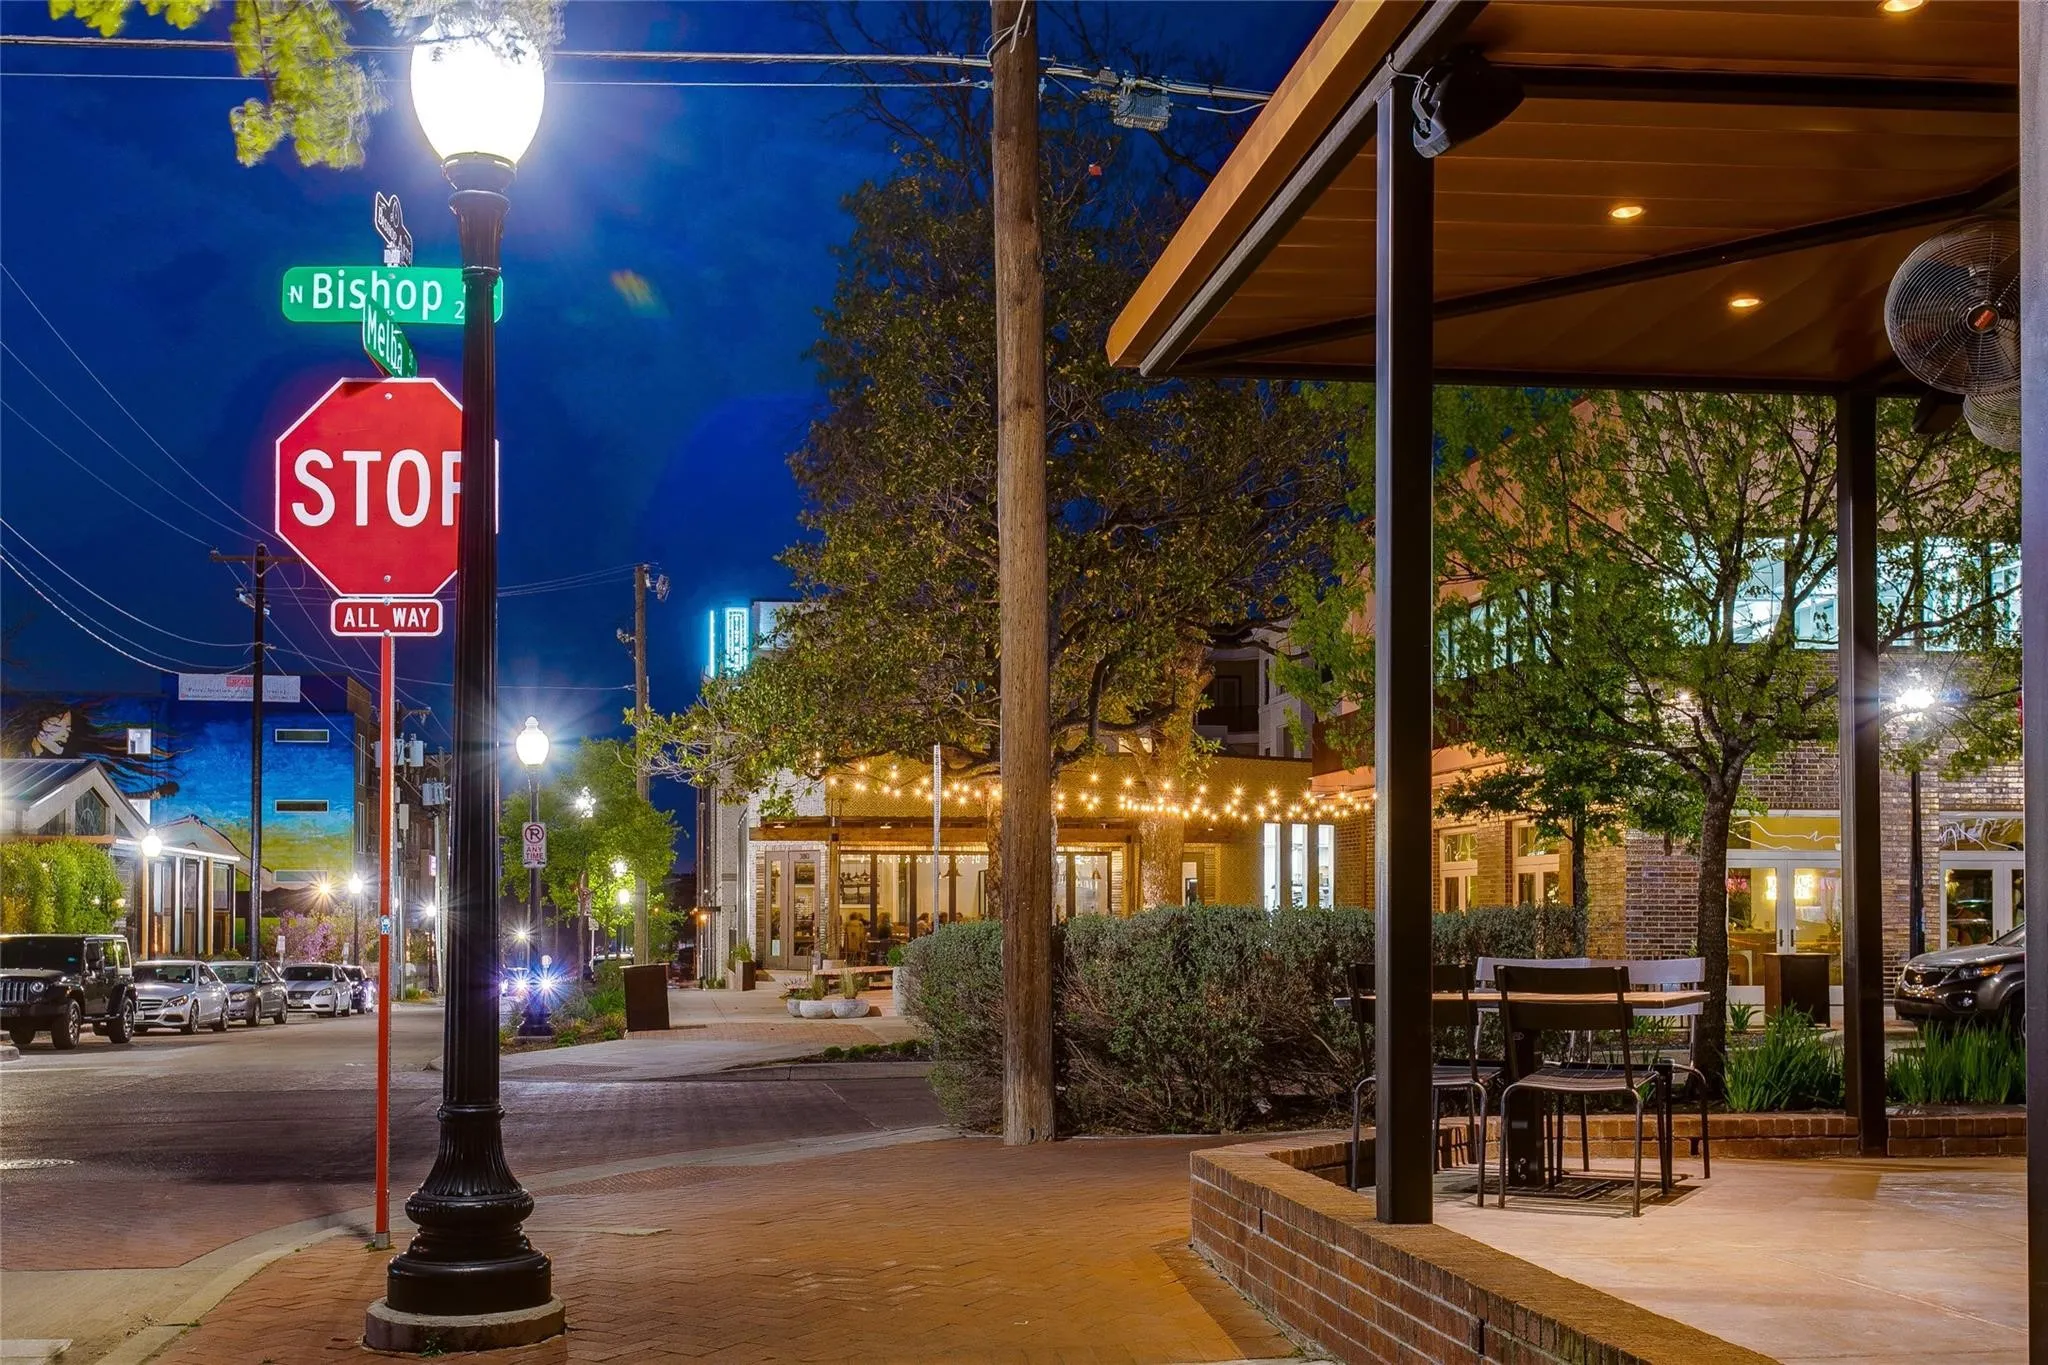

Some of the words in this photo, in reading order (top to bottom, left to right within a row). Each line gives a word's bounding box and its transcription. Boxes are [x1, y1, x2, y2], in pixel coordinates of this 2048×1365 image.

[289, 285, 303, 304] N
[312, 269, 443, 321] Bishop
[367, 304, 403, 377] Melba
[343, 607, 380, 628] ALL
[392, 607, 431, 628] WAY
